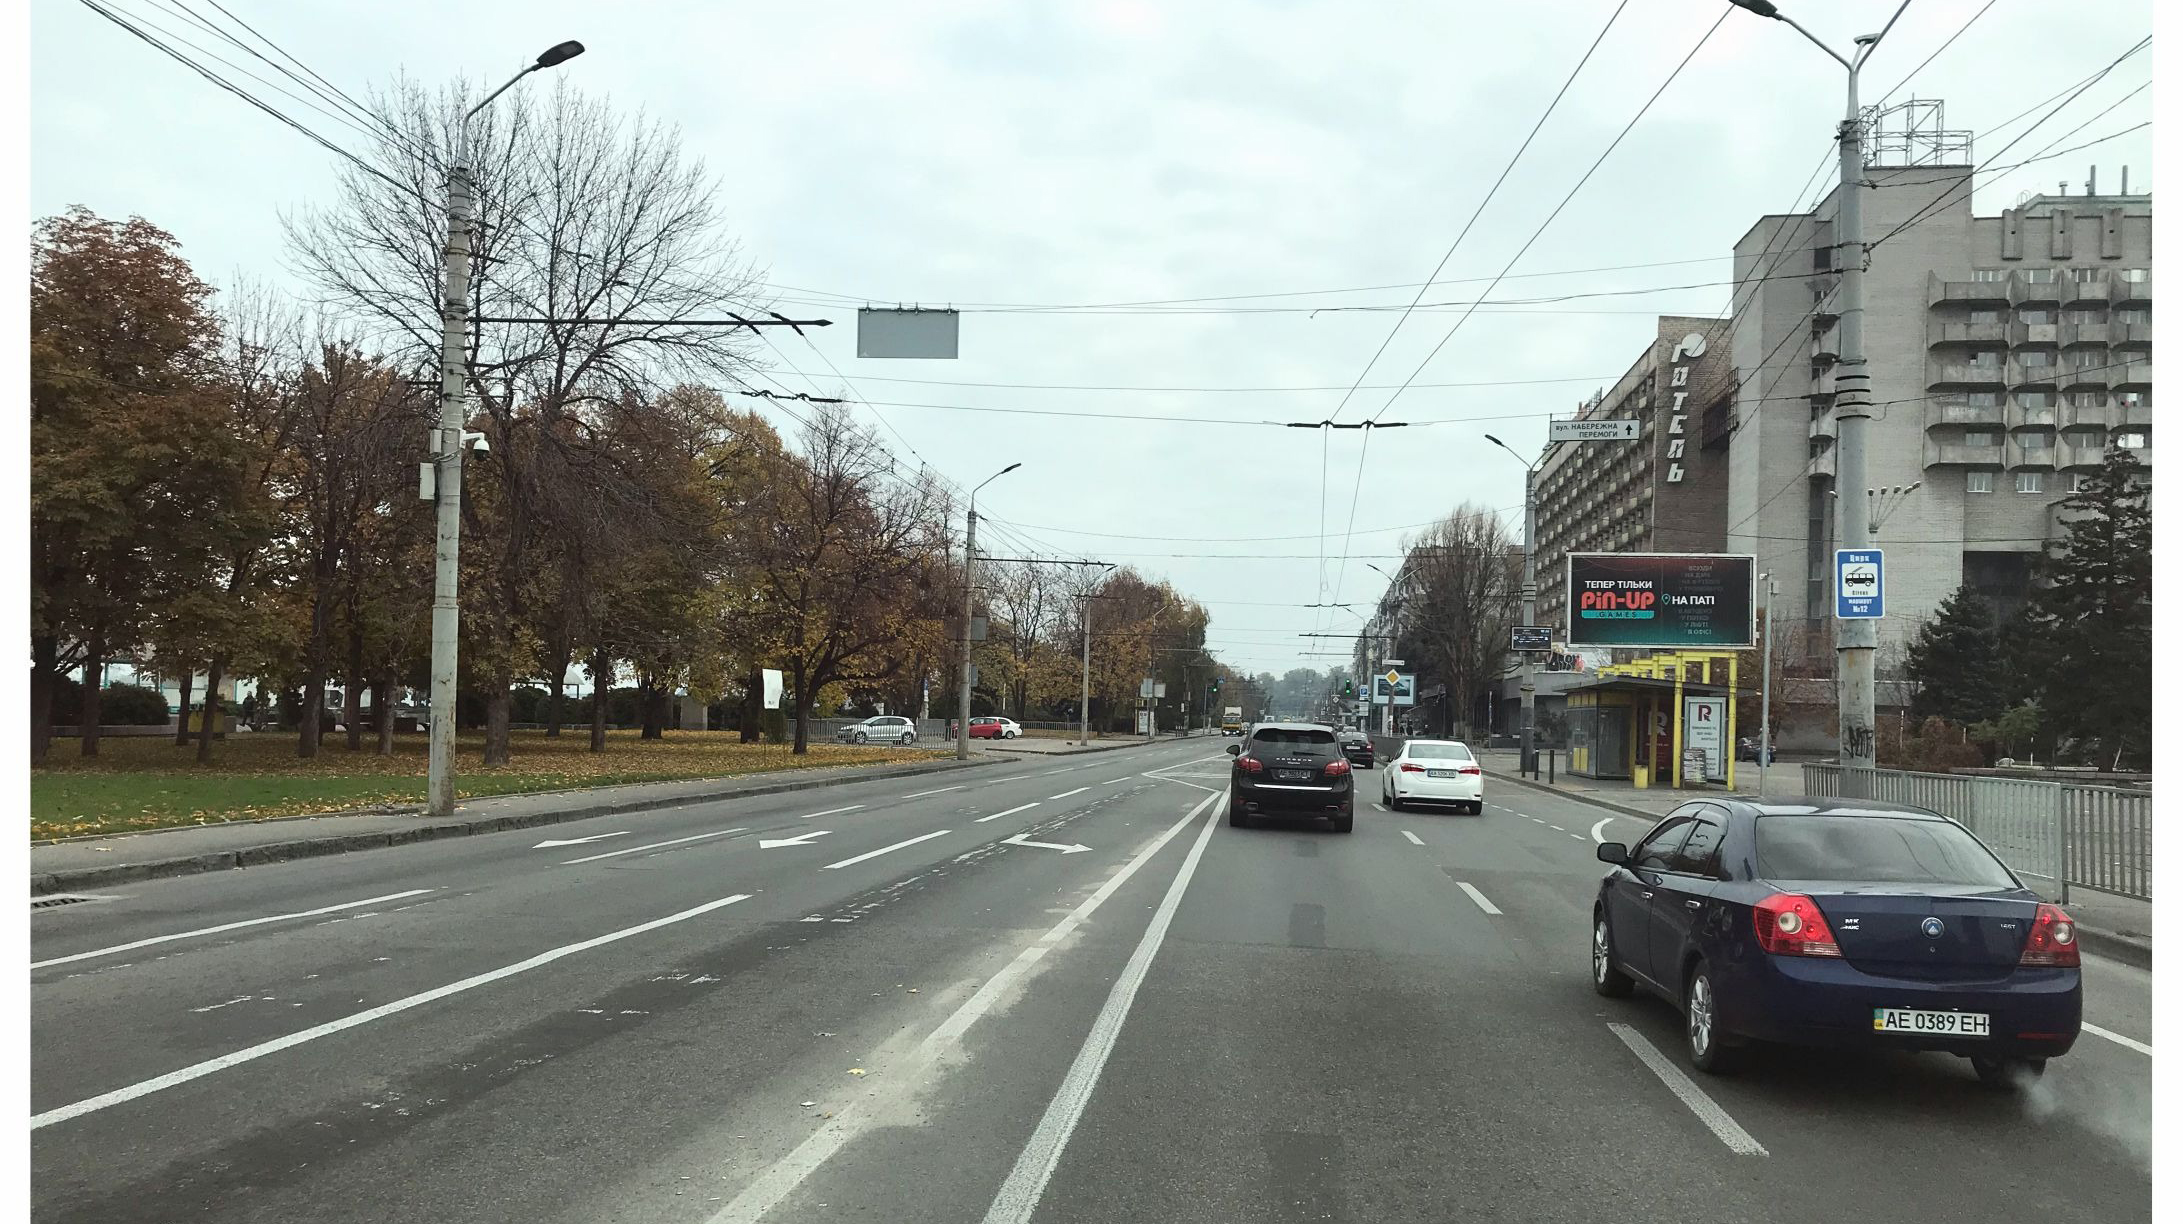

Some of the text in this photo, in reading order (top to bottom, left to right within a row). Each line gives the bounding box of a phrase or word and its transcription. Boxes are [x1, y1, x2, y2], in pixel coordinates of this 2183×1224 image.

[1584, 580, 1652, 589] ТЕПЕР ТІЛЬКИ
[1672, 595, 1715, 605] НА ПАТІ
[1698, 704, 1712, 722] R
[1885, 1011, 1986, 1033] AE 0389 EH
